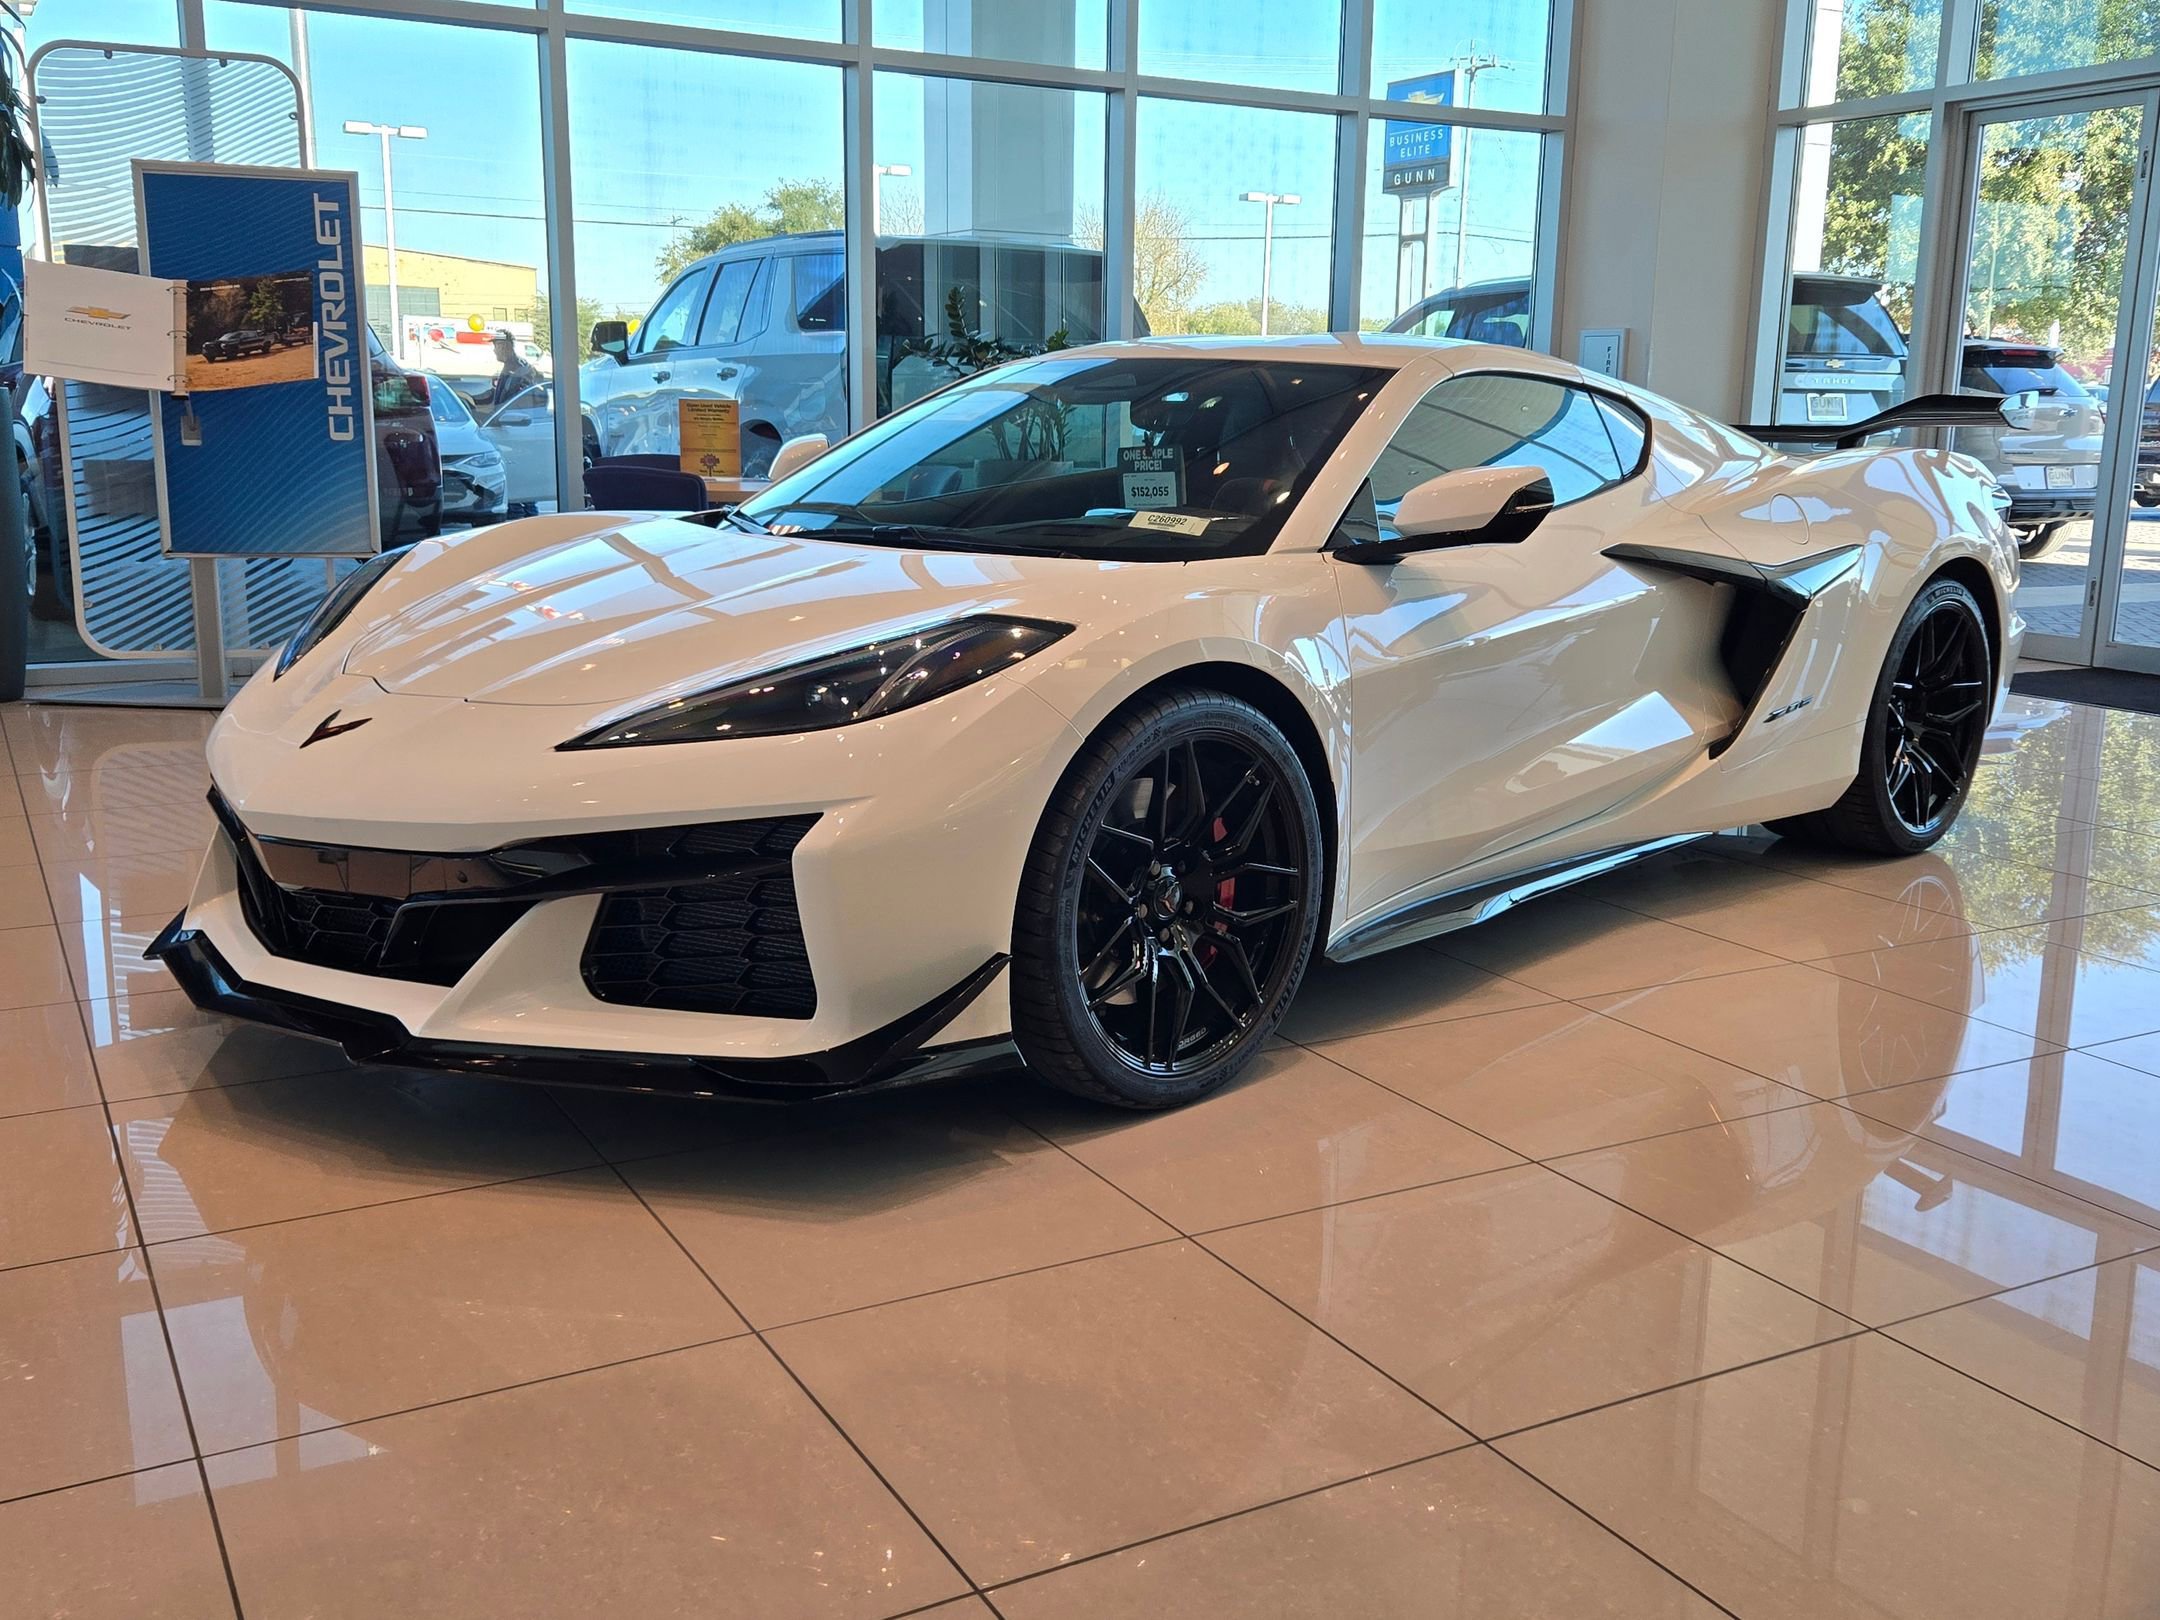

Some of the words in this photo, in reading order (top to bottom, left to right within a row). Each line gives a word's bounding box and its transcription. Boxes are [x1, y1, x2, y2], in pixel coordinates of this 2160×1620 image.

[1389, 128, 1443, 147] BUSINESS
[1400, 144, 1431, 158] ELITE
[1394, 168, 1435, 185] GUNN
[64, 317, 132, 330] CHEVROLET
[313, 192, 354, 441] CHEVROLET
[1123, 450, 1141, 461] ONE
[1142, 448, 1174, 460] SMPLE
[1134, 460, 1163, 471] PRICE!
[1131, 486, 1169, 499] $152,055
[1147, 514, 1188, 526] C260992
[1071, 777, 1114, 864] MICHELIN
[1274, 940, 1308, 1017] MICHELIN
[1177, 1026, 1207, 1047] ORGED
